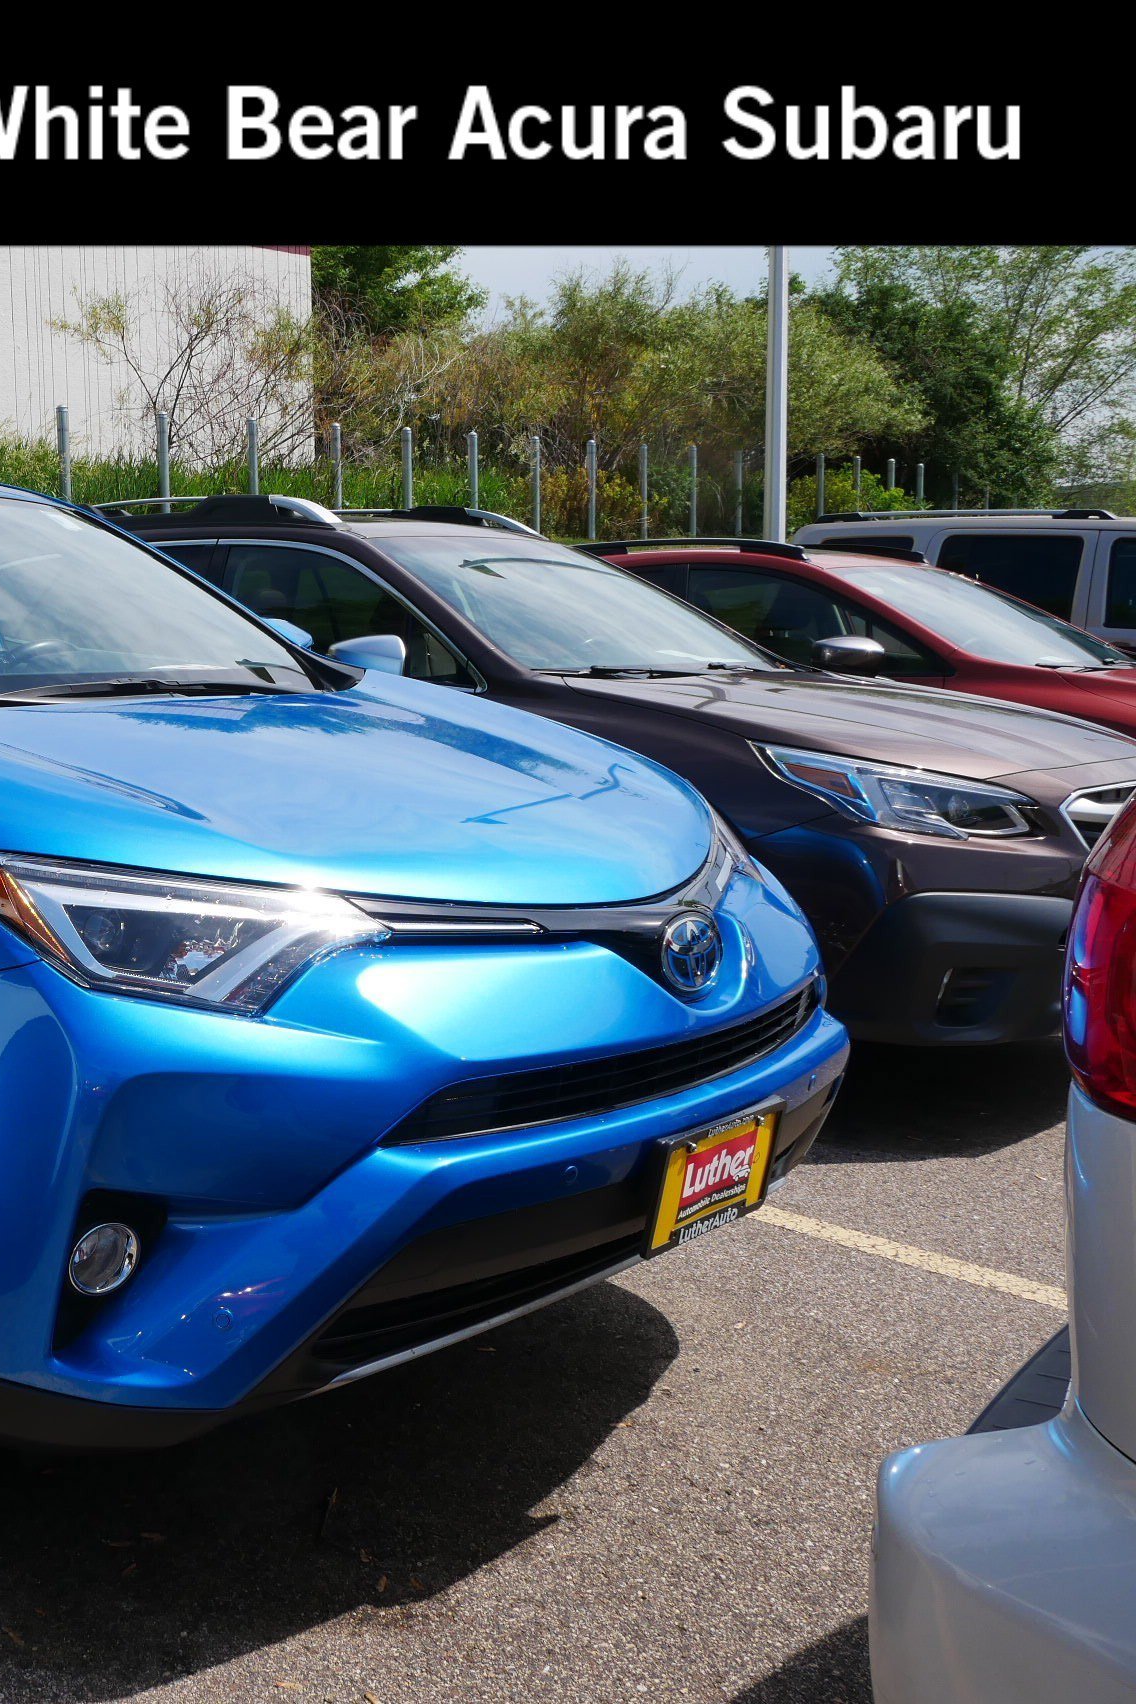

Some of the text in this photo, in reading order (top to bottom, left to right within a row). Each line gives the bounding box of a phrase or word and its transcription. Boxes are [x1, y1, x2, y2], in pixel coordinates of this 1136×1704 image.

[682, 1144, 755, 1199] Luther
[678, 1183, 747, 1220] Automobile Dealerships
[678, 1207, 739, 1245] LutherAuto
